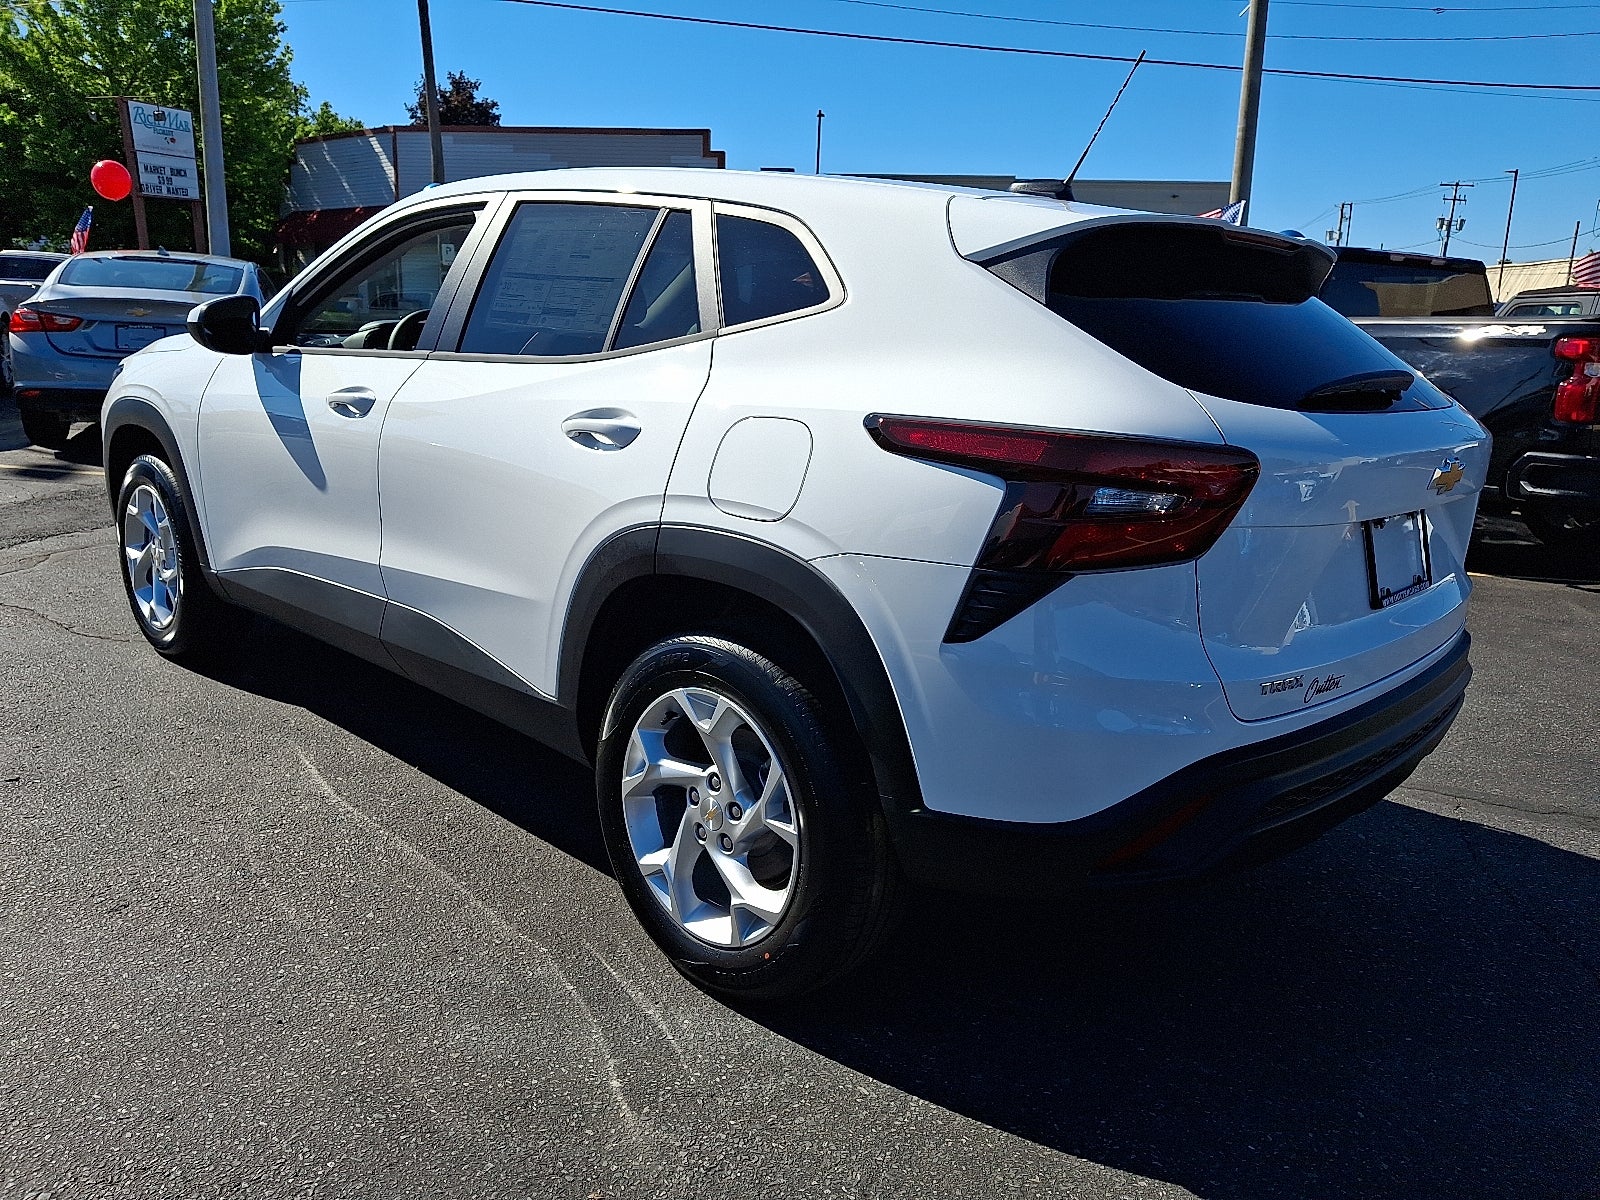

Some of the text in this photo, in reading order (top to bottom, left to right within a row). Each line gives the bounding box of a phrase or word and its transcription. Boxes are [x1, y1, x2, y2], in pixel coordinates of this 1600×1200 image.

[144, 164, 166, 175] MARKET
[141, 183, 189, 196] DRIVER WANTED
